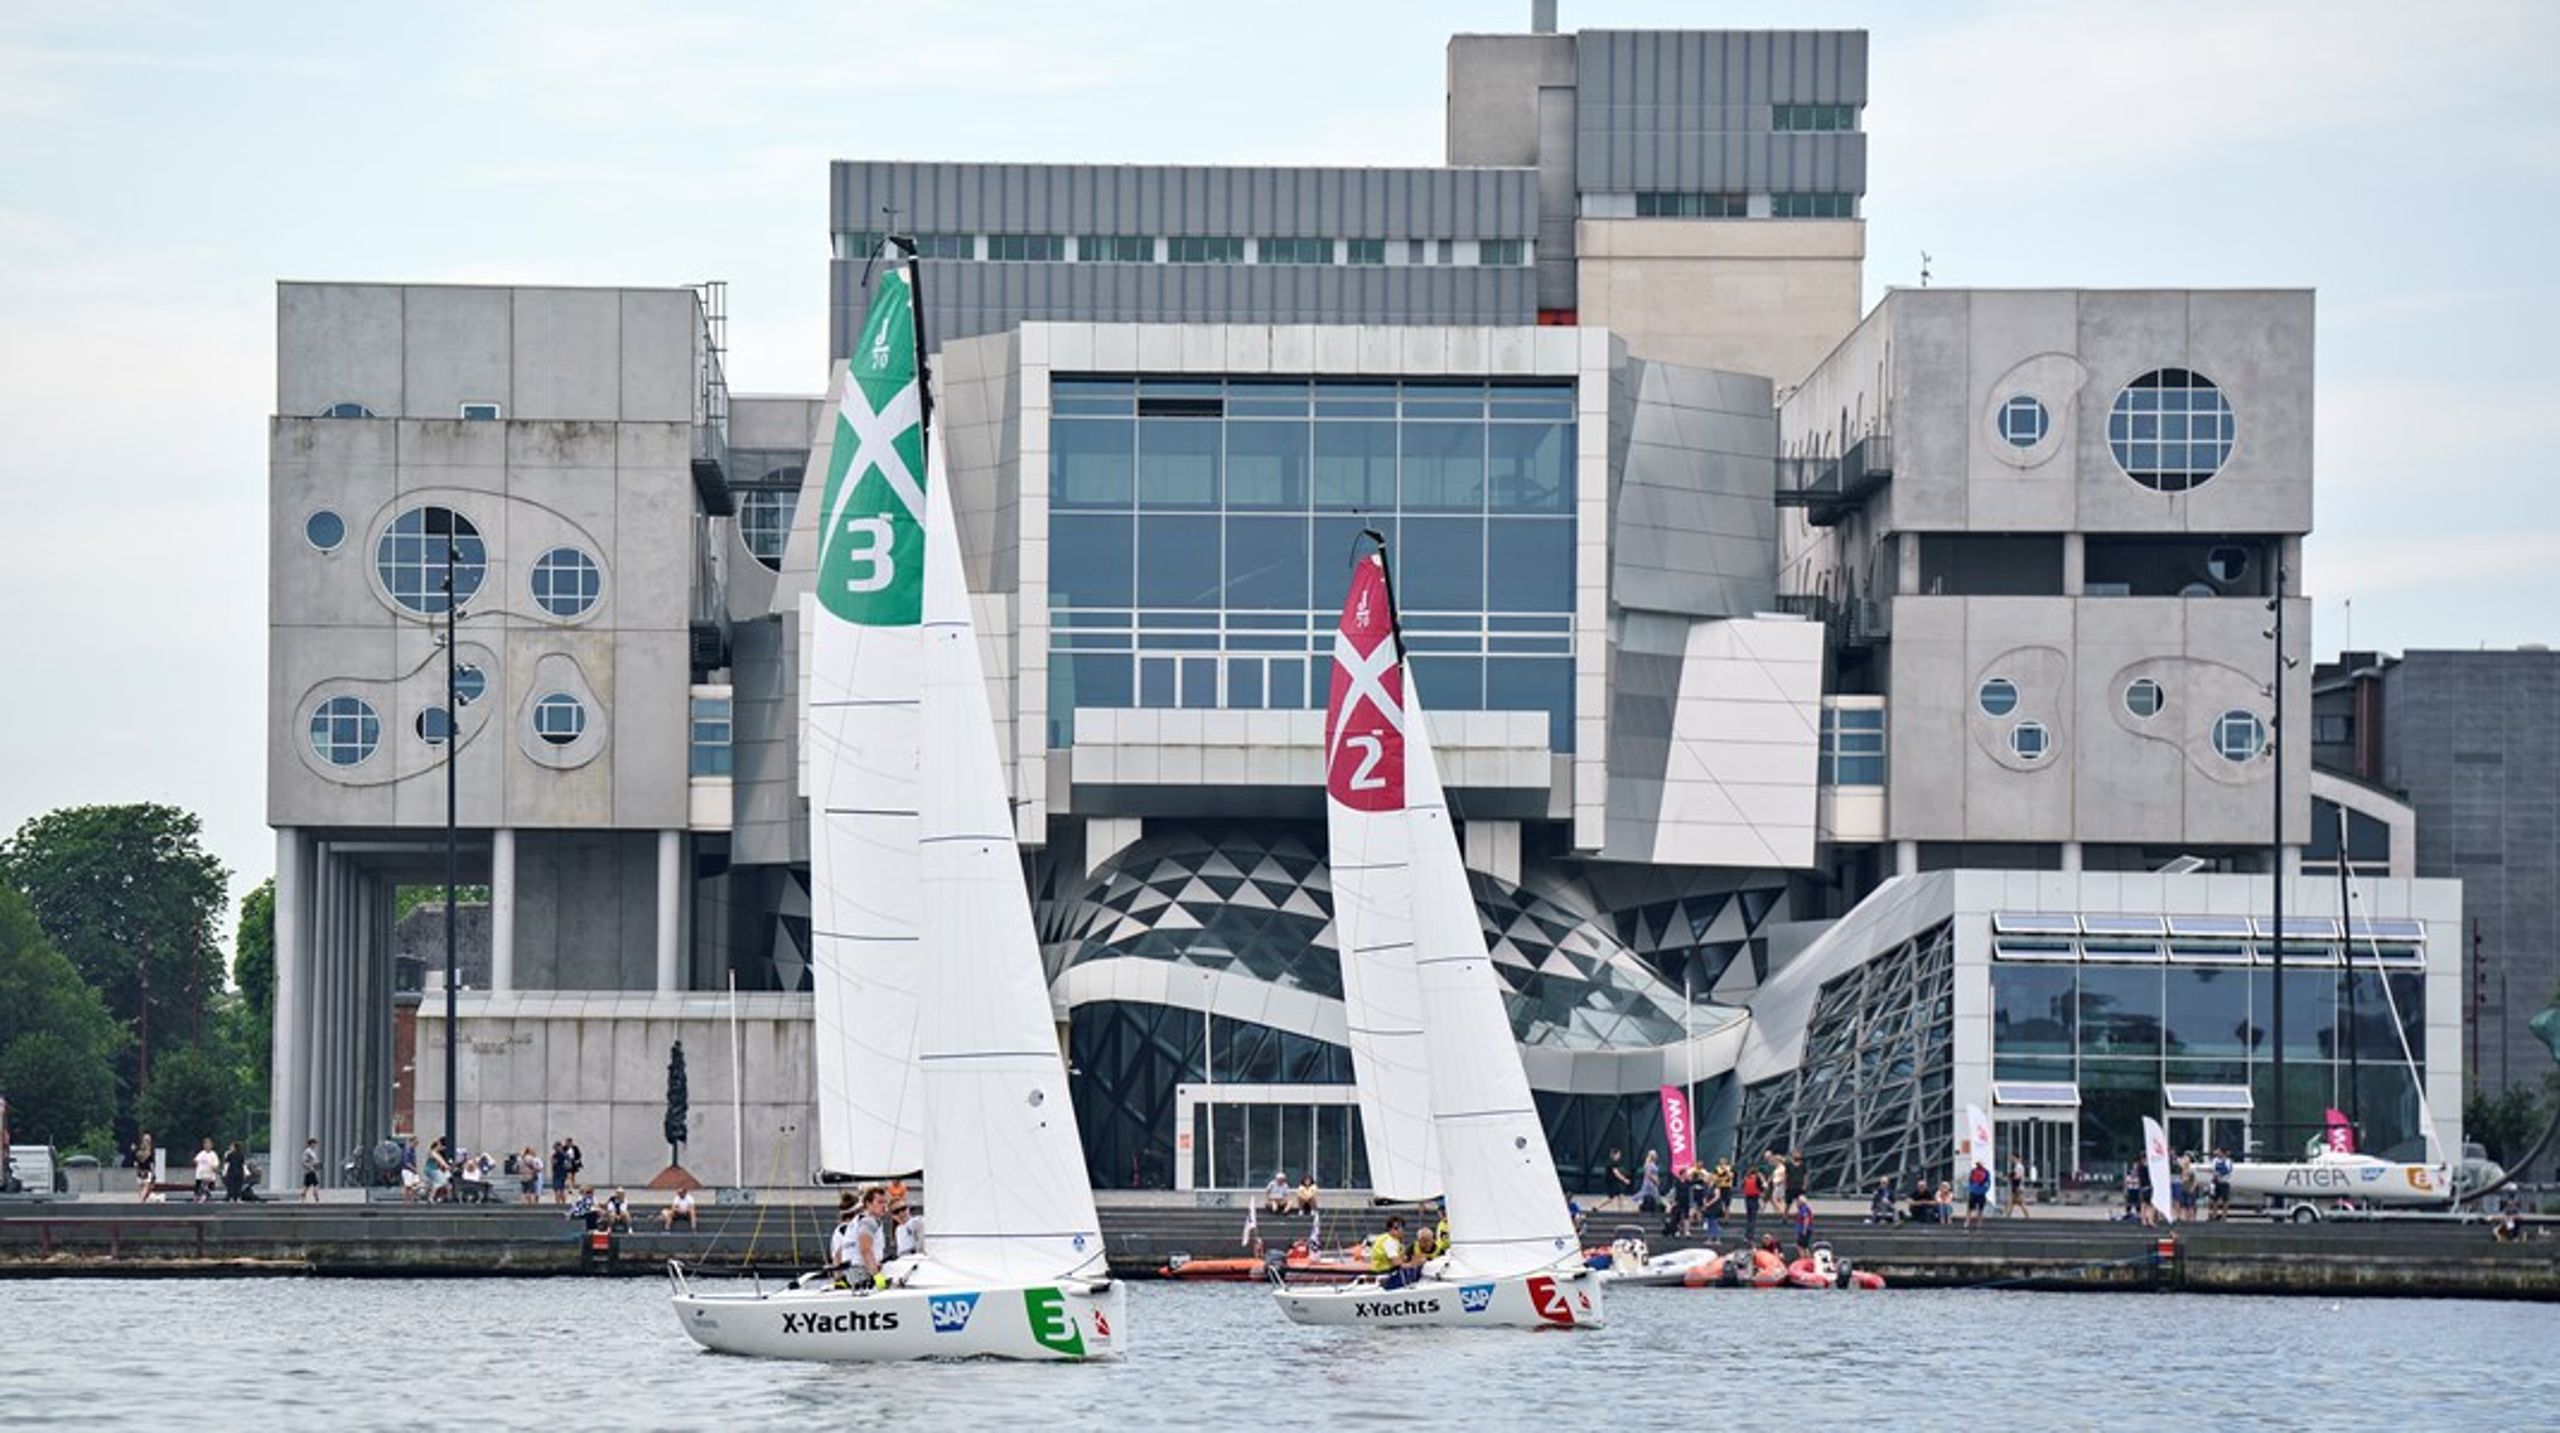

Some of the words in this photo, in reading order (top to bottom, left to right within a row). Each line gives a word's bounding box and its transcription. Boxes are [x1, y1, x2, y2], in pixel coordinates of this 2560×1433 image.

[846, 518, 895, 592] 3
[1346, 735, 1387, 790] 2
[1667, 1098, 1686, 1154] WOW
[2284, 1169, 2350, 1187] ATEA
[1356, 1298, 1440, 1318] X-Yachts
[1461, 1286, 1489, 1309] SAP
[1540, 1286, 1568, 1315] 2
[782, 1310, 899, 1334] X-Yachts
[931, 1300, 970, 1327] SAP
[1042, 1301, 1076, 1341] 3
